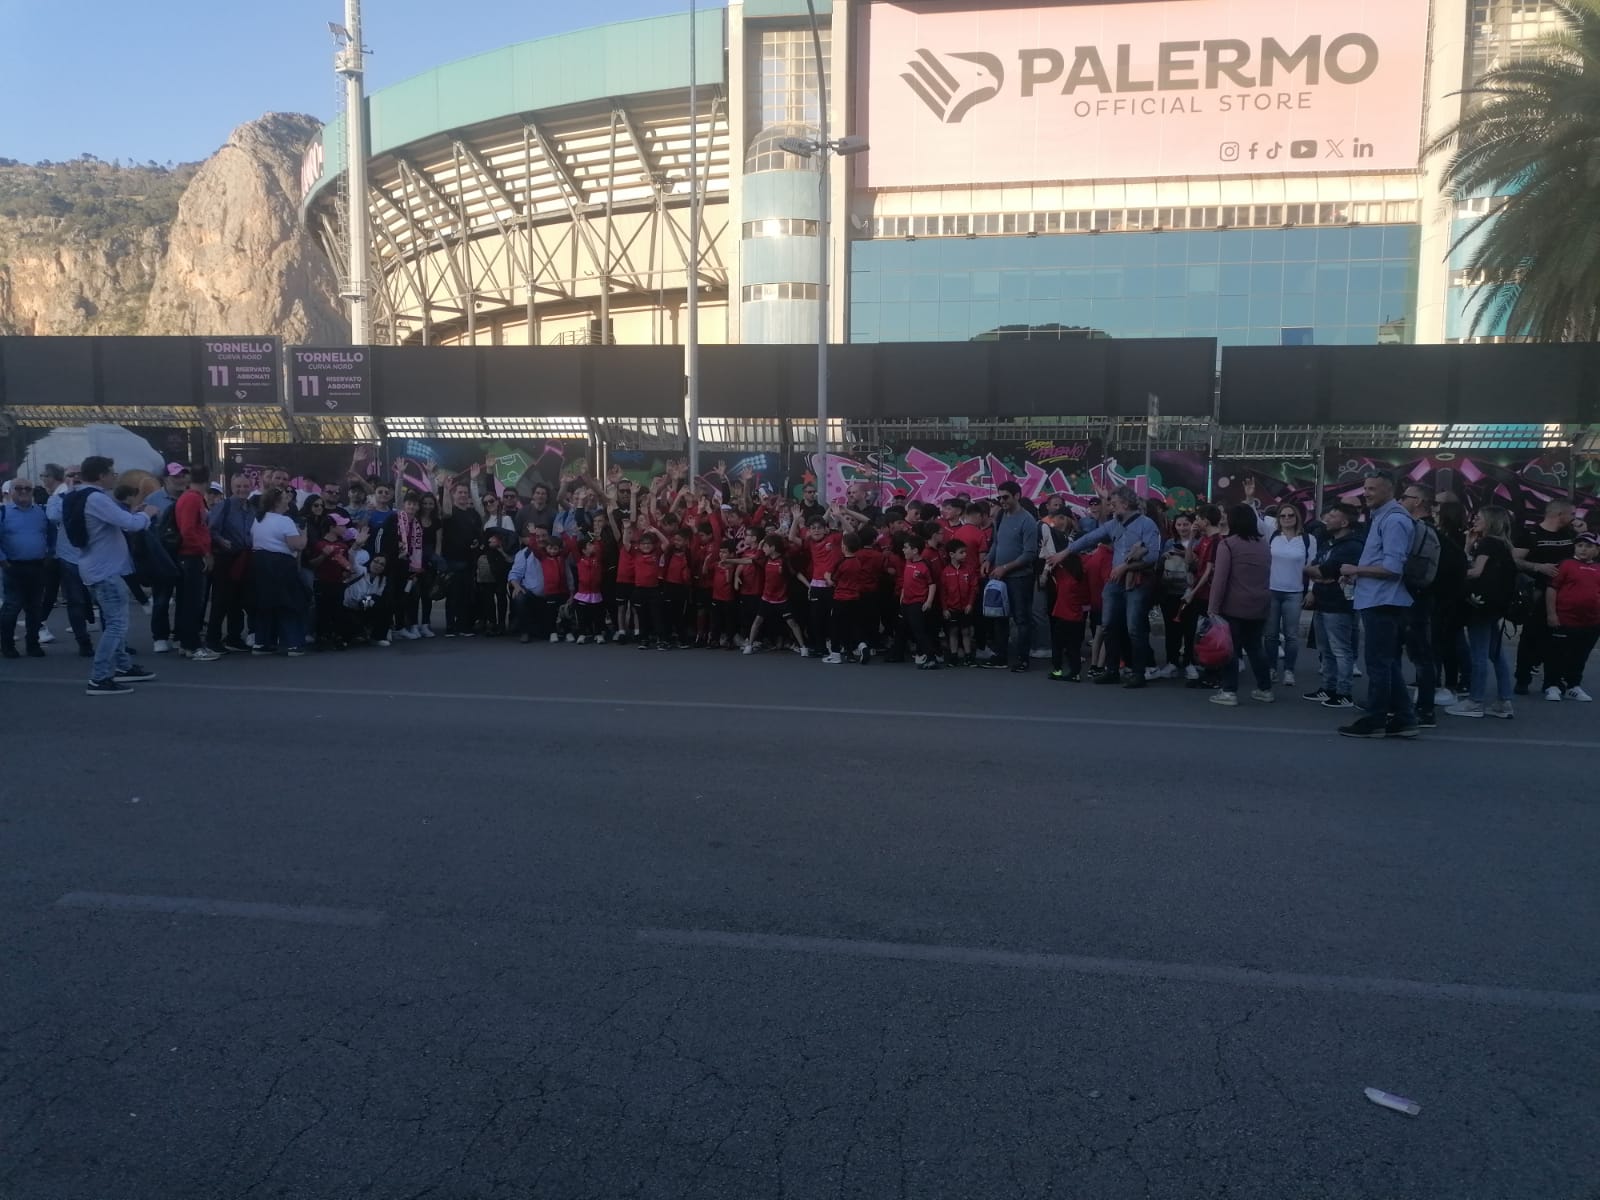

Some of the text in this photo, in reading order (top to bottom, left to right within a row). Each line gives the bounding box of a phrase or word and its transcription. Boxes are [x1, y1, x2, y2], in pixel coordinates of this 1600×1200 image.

[1019, 32, 1379, 97] PALERMO
[1074, 91, 1313, 118] OFFICIAL STORE
[206, 343, 272, 352] TORNELLO
[296, 353, 363, 362] TORNELLO
[208, 366, 229, 386] 11
[298, 376, 319, 396] 11
